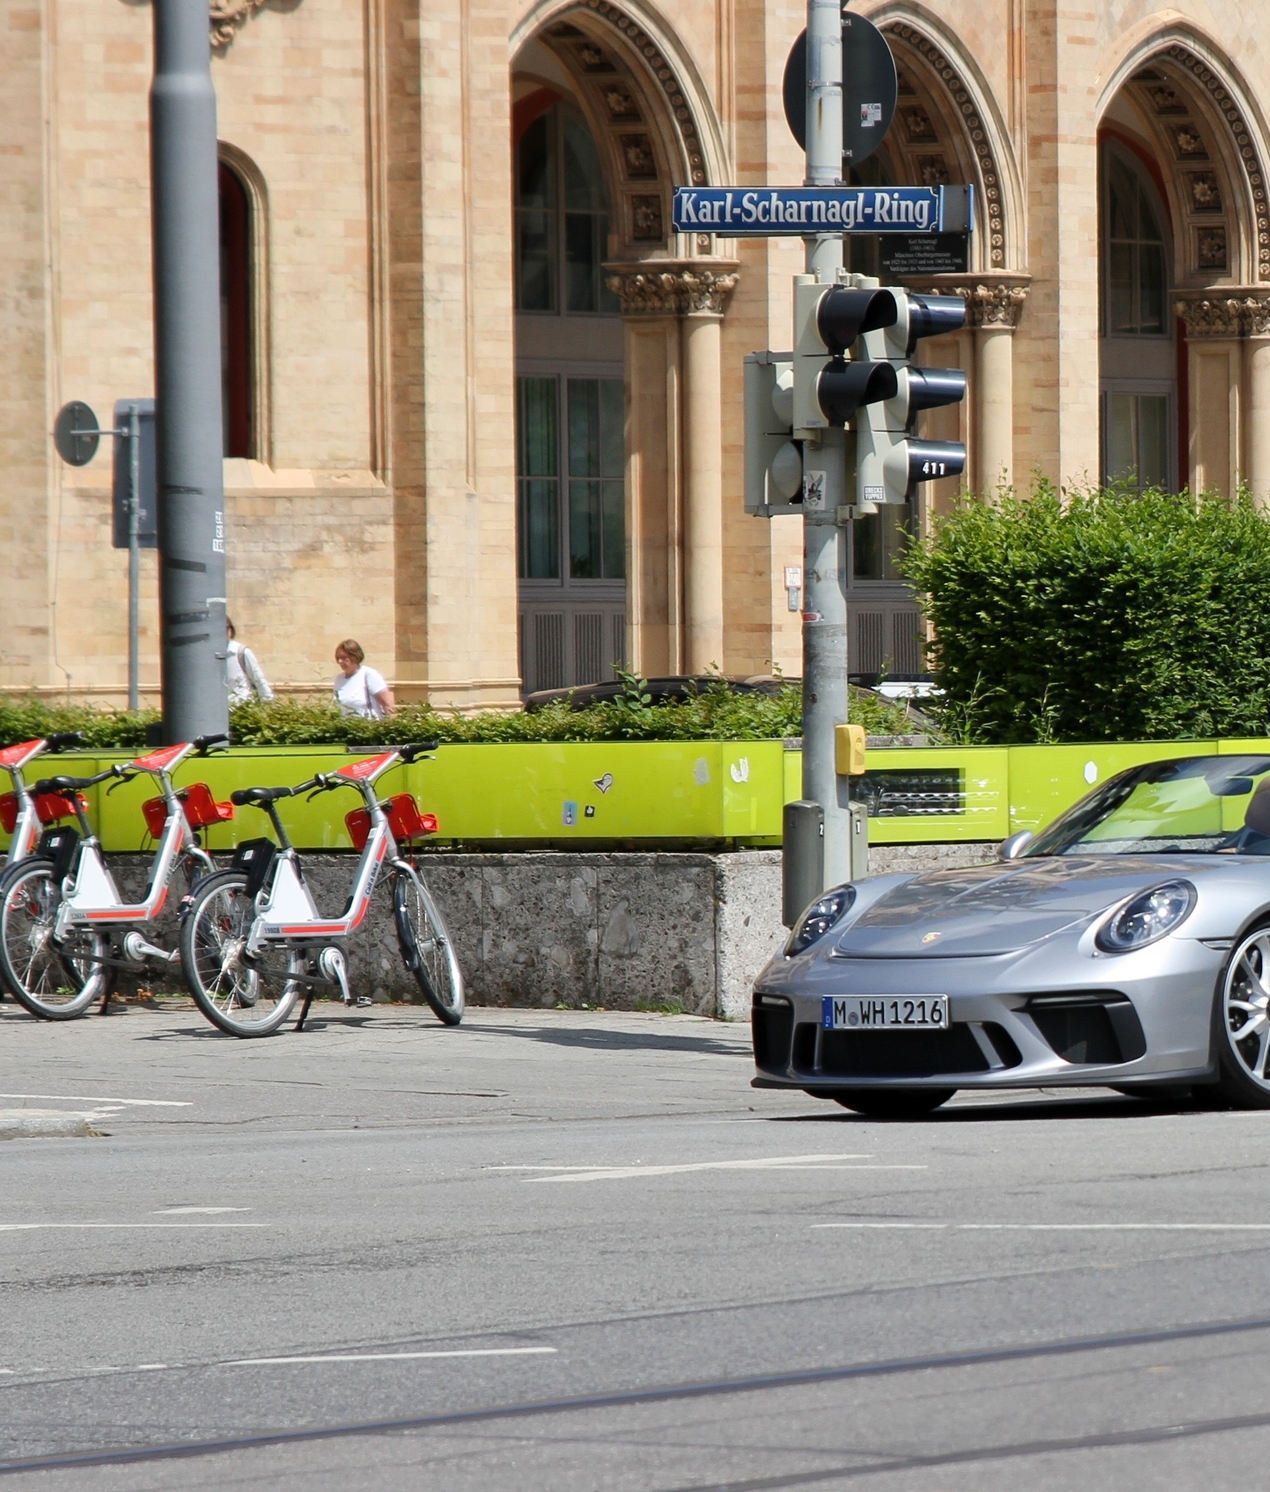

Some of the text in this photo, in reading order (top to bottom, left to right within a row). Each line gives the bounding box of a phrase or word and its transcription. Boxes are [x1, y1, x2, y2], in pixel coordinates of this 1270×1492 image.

[680, 192, 930, 228] Karl-Scharnagl-Ring
[922, 462, 945, 476] 411
[834, 1000, 943, 1024] M WH 1216
